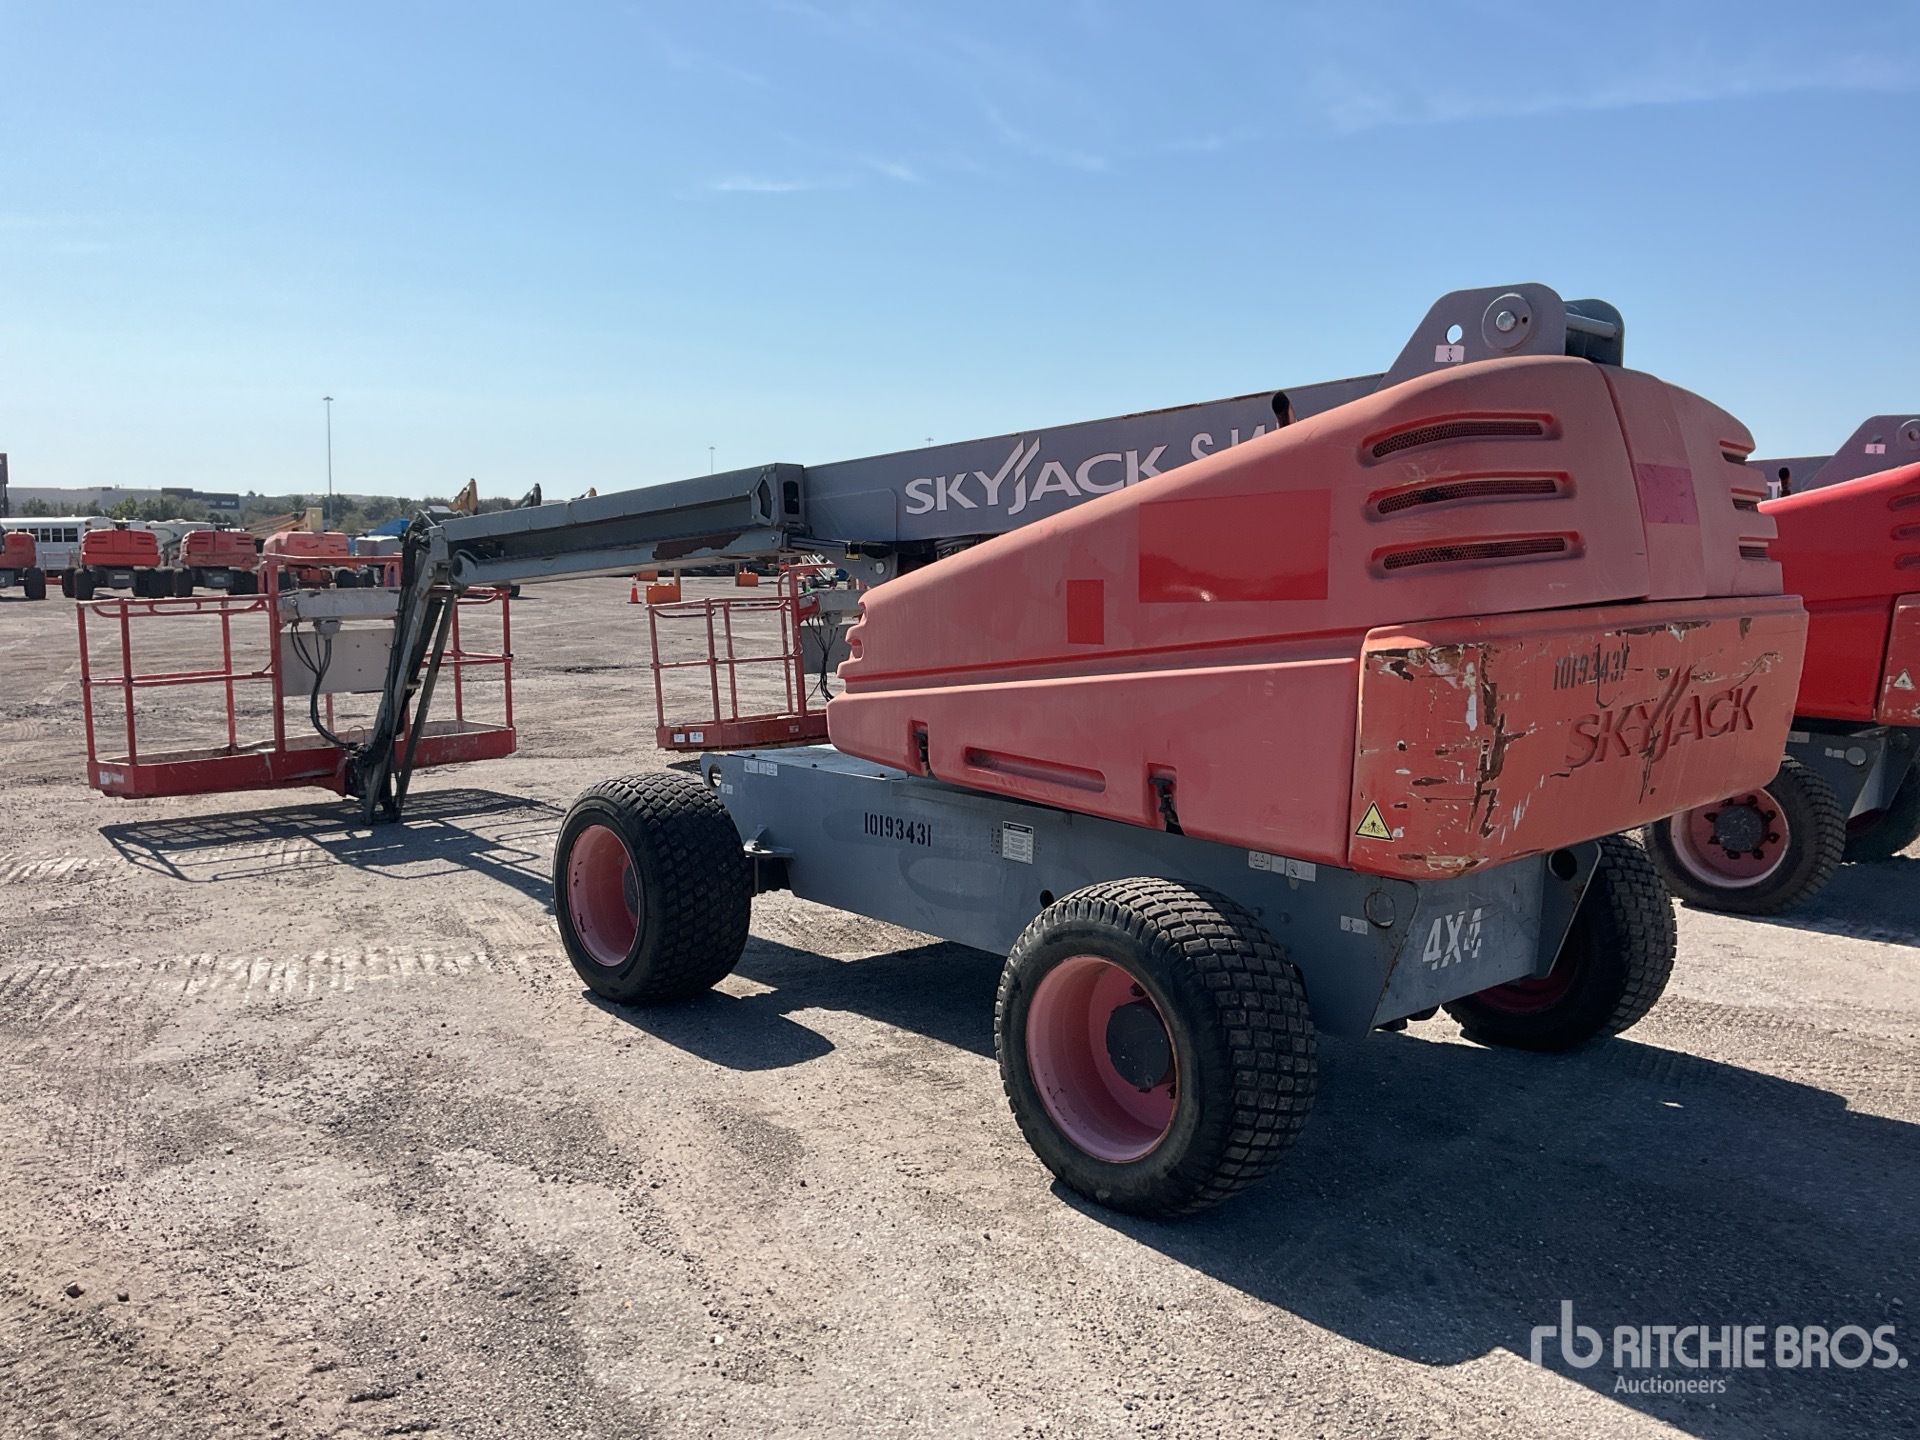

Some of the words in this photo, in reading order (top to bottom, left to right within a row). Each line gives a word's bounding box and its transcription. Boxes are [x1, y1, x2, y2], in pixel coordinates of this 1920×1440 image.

[905, 436, 1169, 515] SKYJACK
[1565, 666, 1758, 769] SKYJACK
[864, 812, 932, 847] 10193431
[1422, 908, 1482, 970] 4X4
